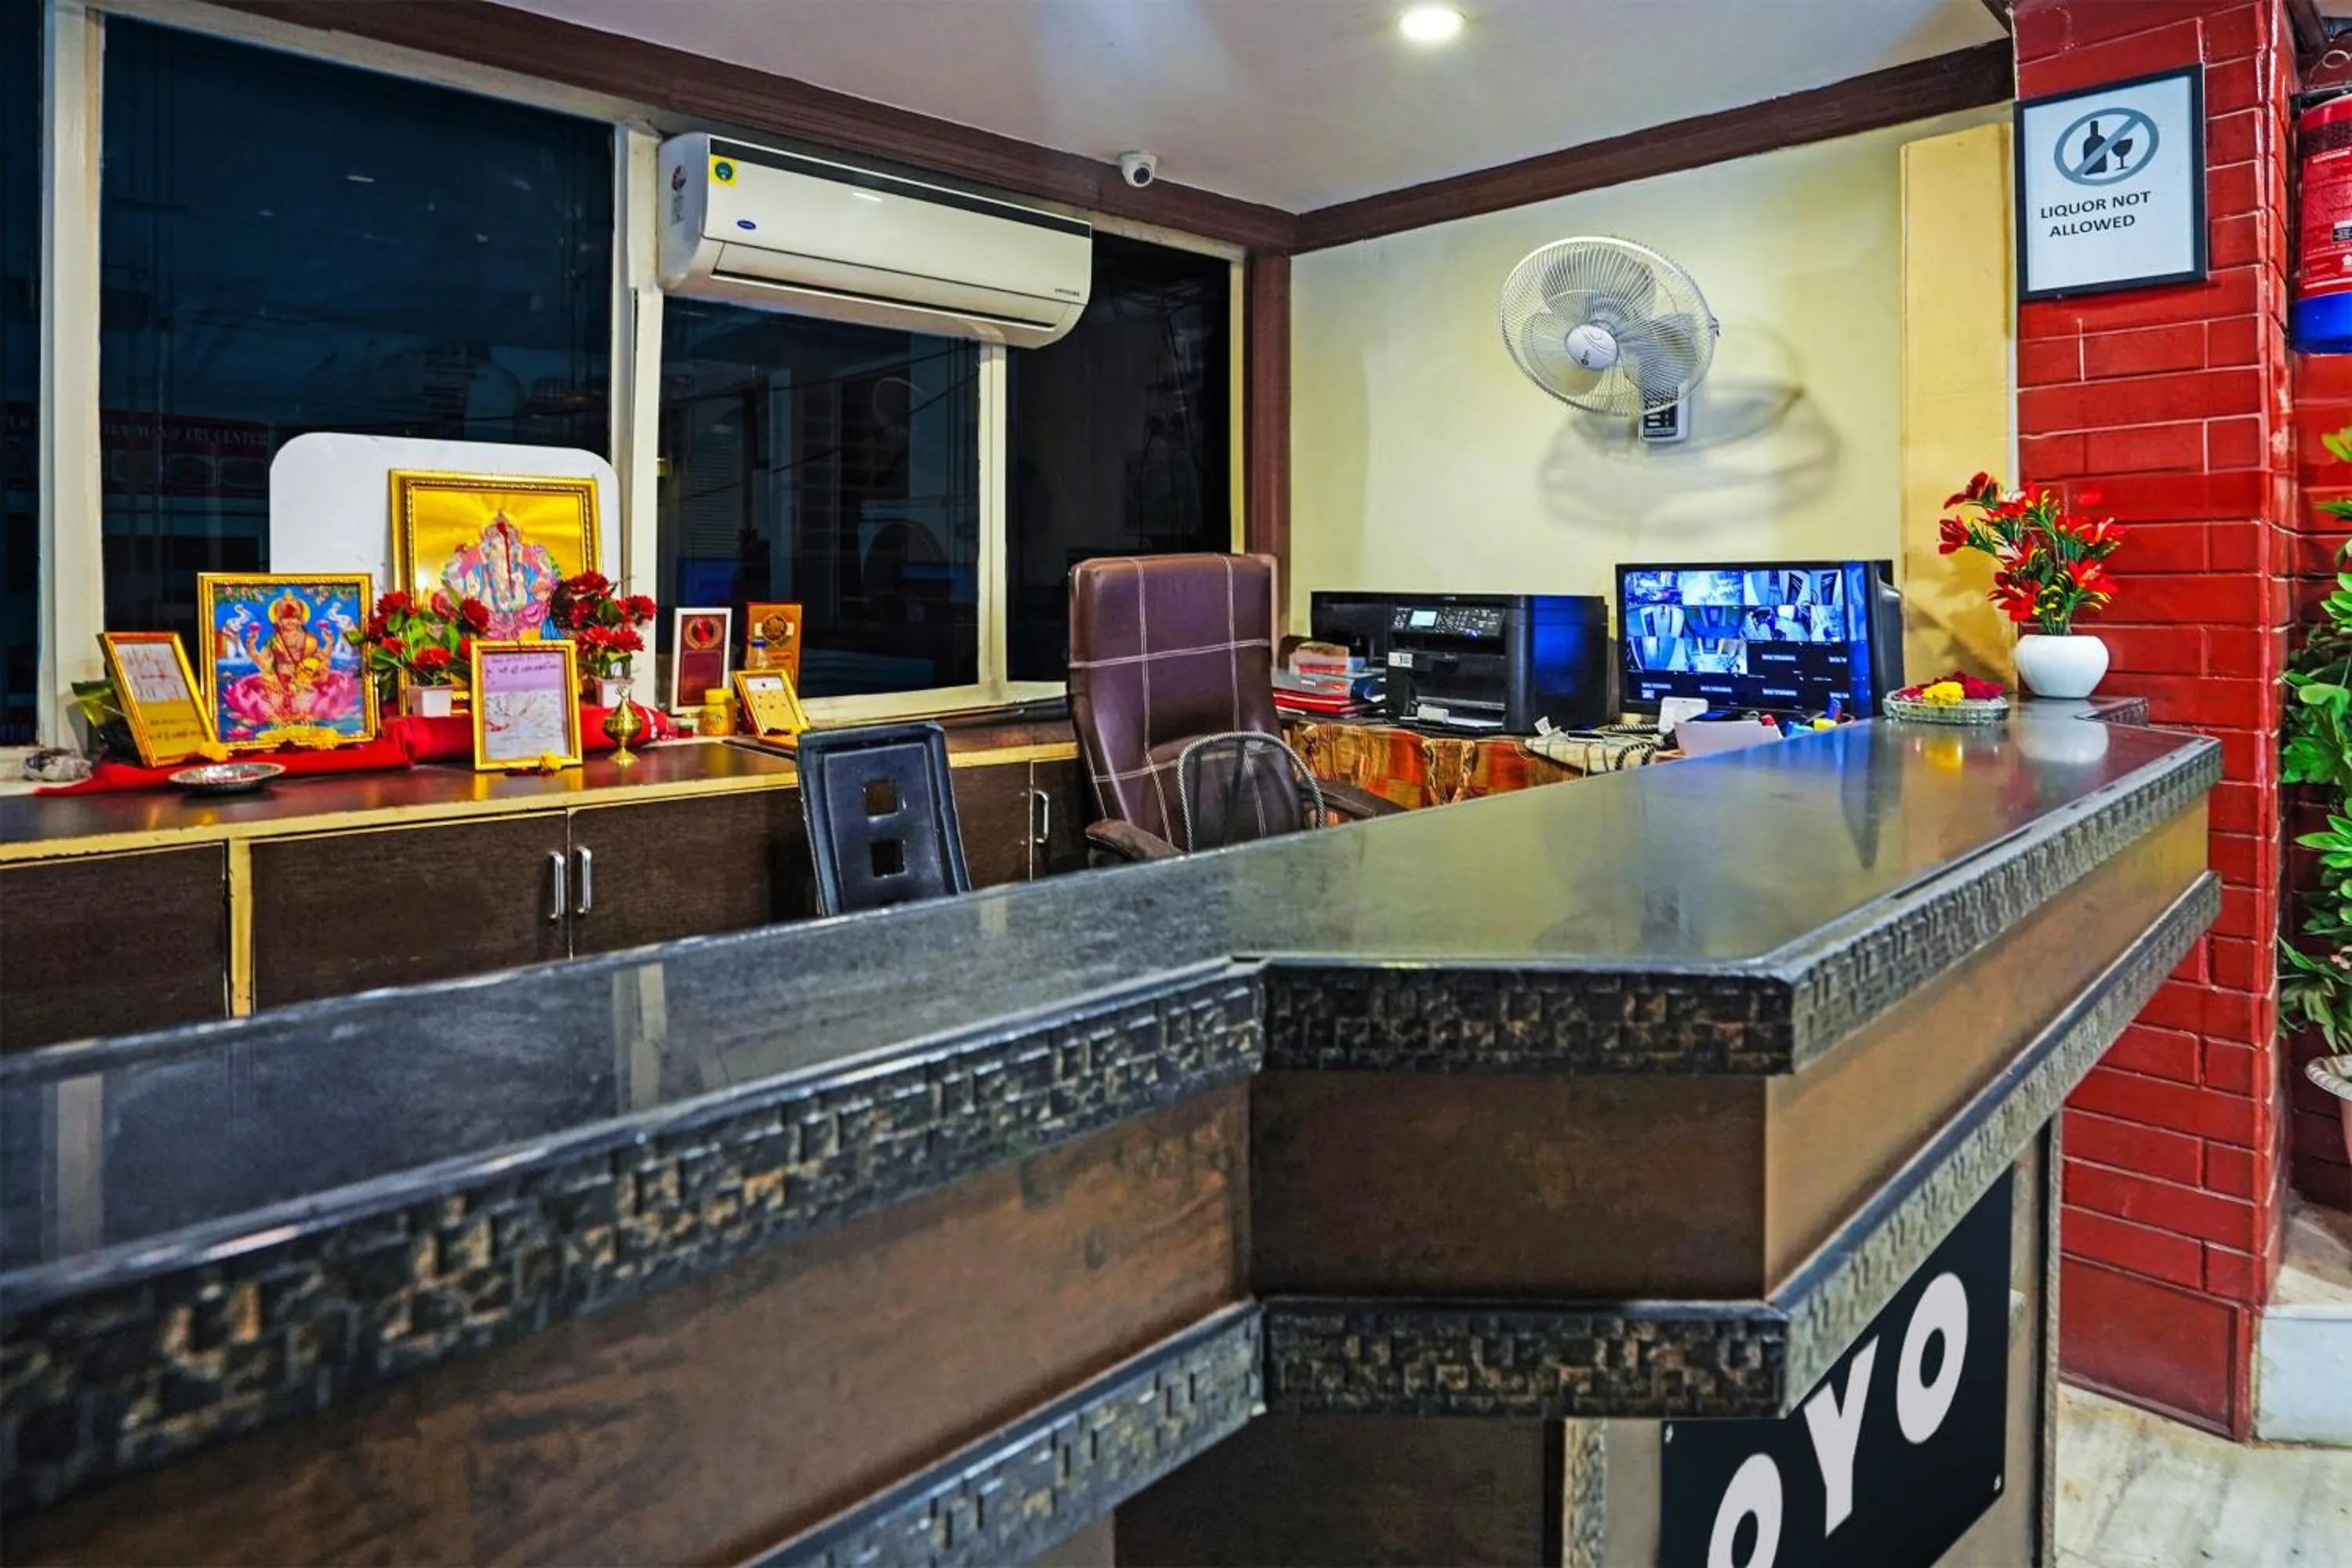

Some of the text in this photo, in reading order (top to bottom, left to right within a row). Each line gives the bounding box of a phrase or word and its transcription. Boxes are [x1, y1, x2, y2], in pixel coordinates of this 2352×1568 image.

[2041, 191, 2151, 219] LIQUOR NOT
[2049, 214, 2136, 238] ALLOWED
[1707, 1272, 1969, 1568] OYO
